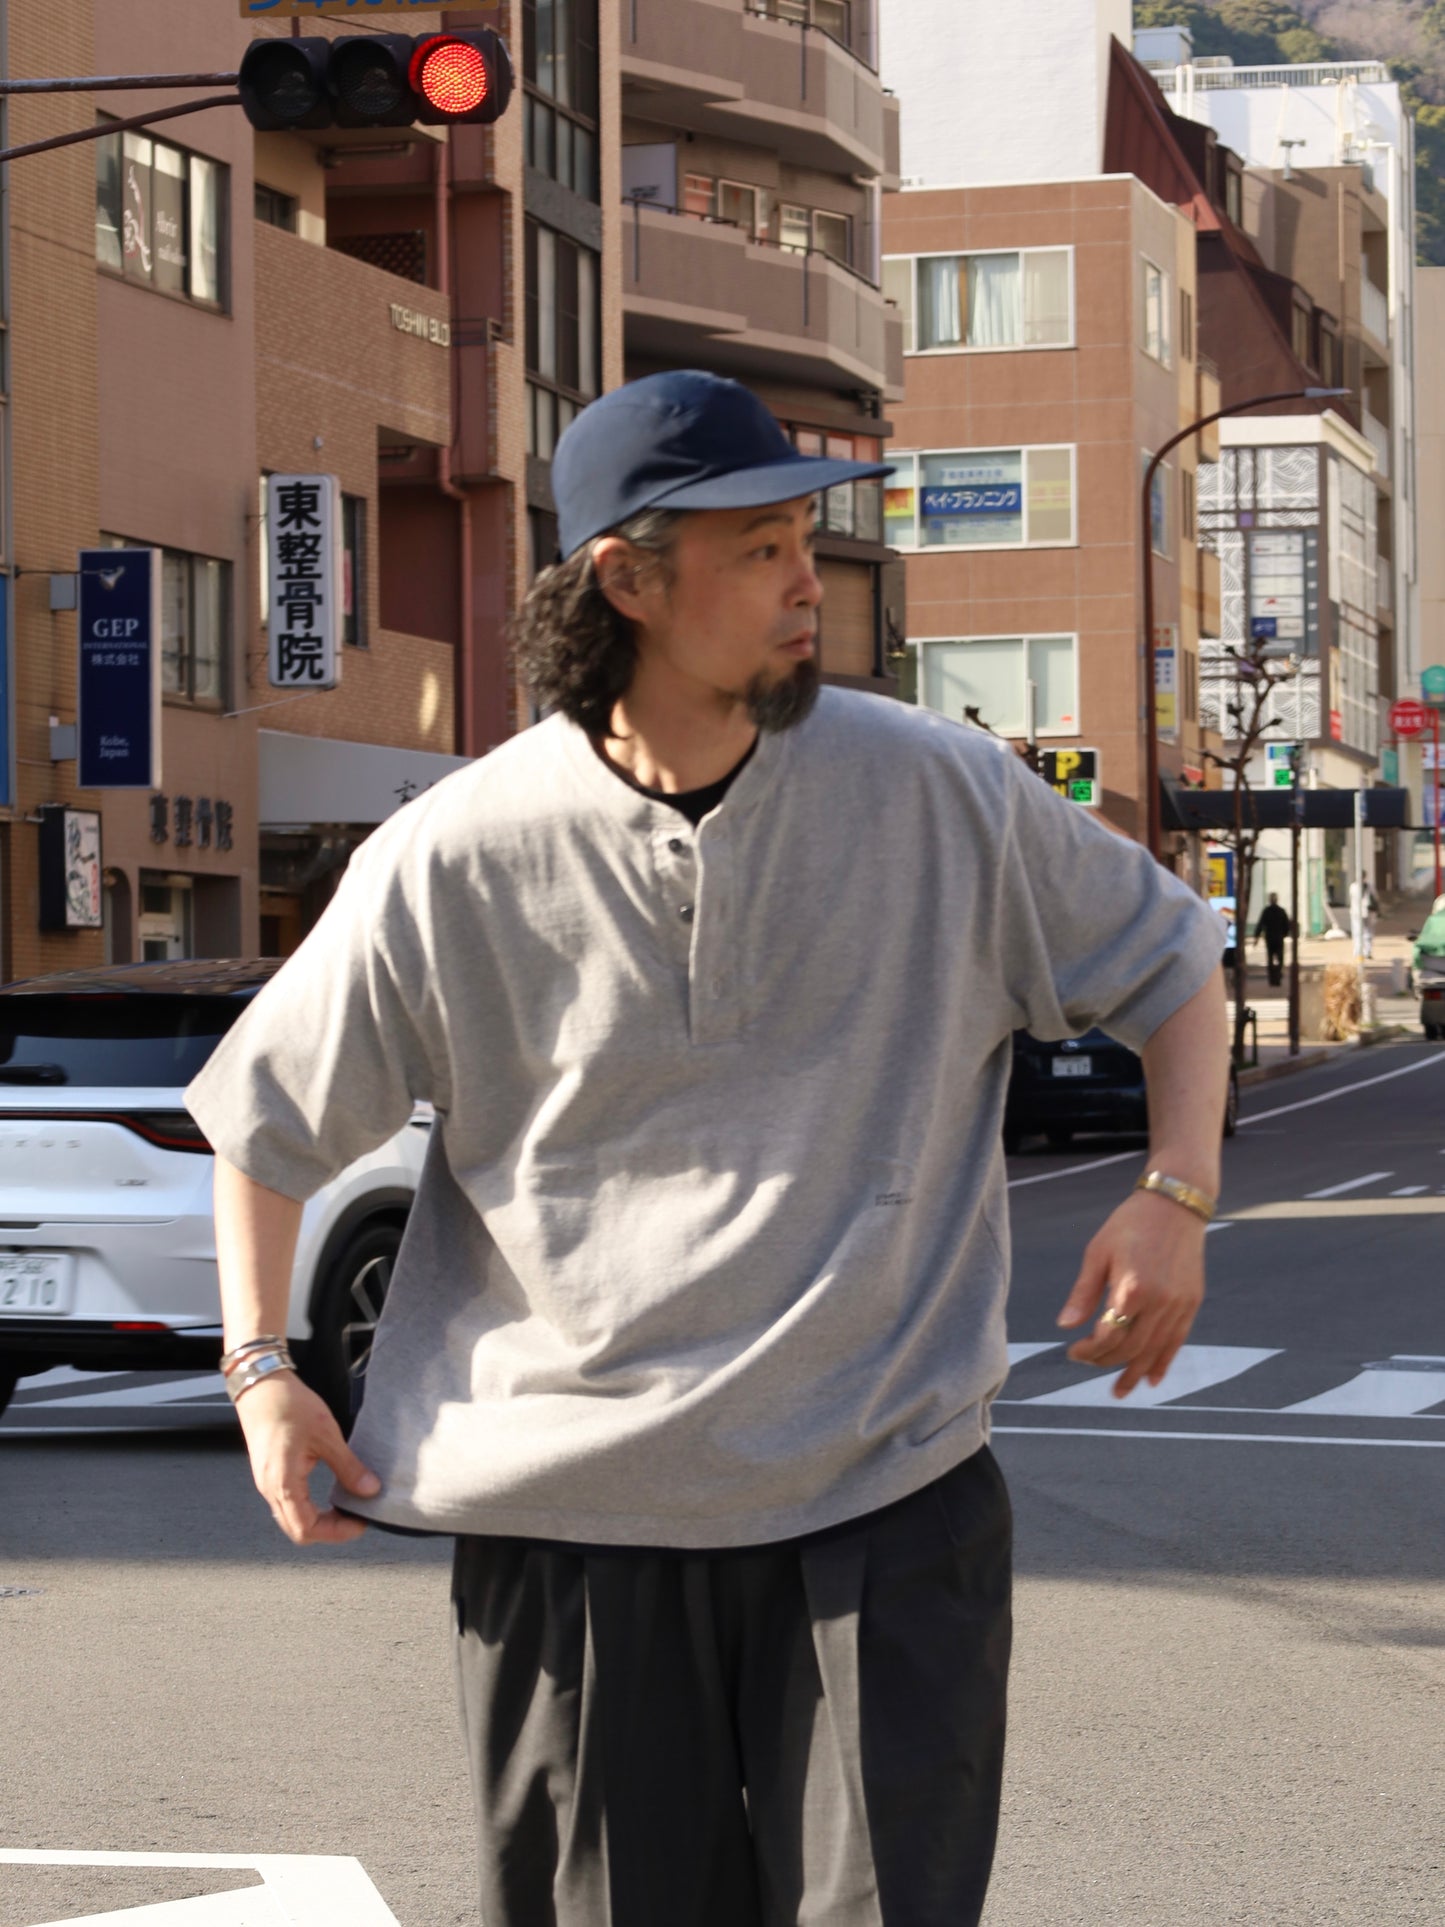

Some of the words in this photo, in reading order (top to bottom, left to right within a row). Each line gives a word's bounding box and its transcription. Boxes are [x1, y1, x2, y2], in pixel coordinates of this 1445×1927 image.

[389, 303, 428, 339] TOSHIN
[276, 481, 324, 681] 東整骨院
[92, 618, 139, 637] GEP
[91, 653, 140, 666] 株式会社
[99, 747, 129, 760] Japan
[1056, 751, 1081, 780] P
